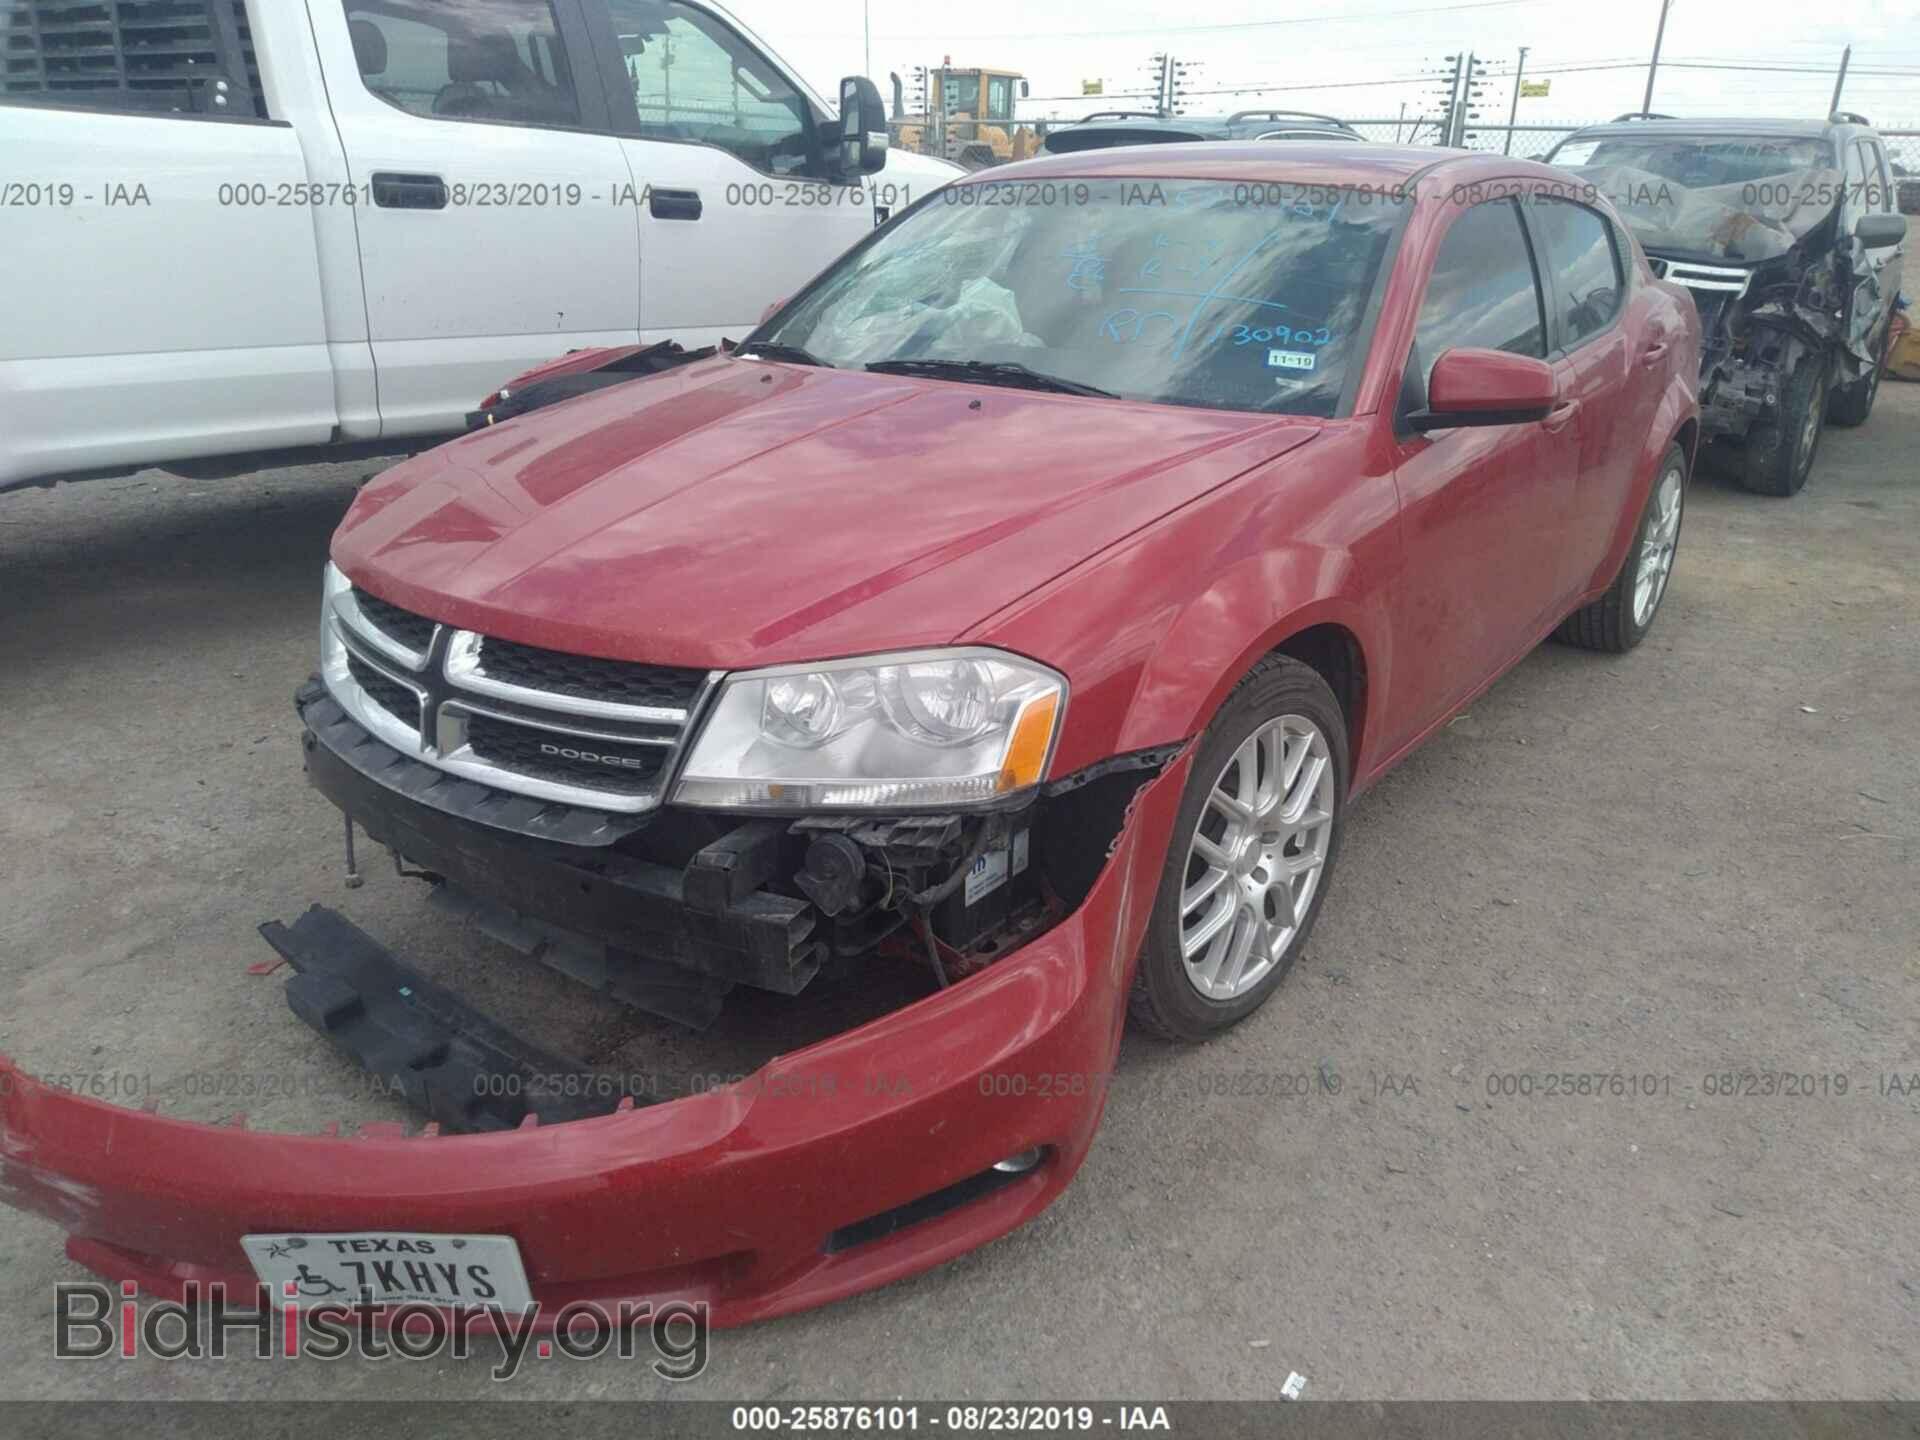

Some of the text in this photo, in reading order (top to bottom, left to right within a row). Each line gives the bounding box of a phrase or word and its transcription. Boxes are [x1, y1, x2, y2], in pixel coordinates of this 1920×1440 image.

[540, 743, 642, 769] DODGE
[328, 1239, 436, 1255] TEXAS
[340, 1260, 496, 1298] 7KHYS
